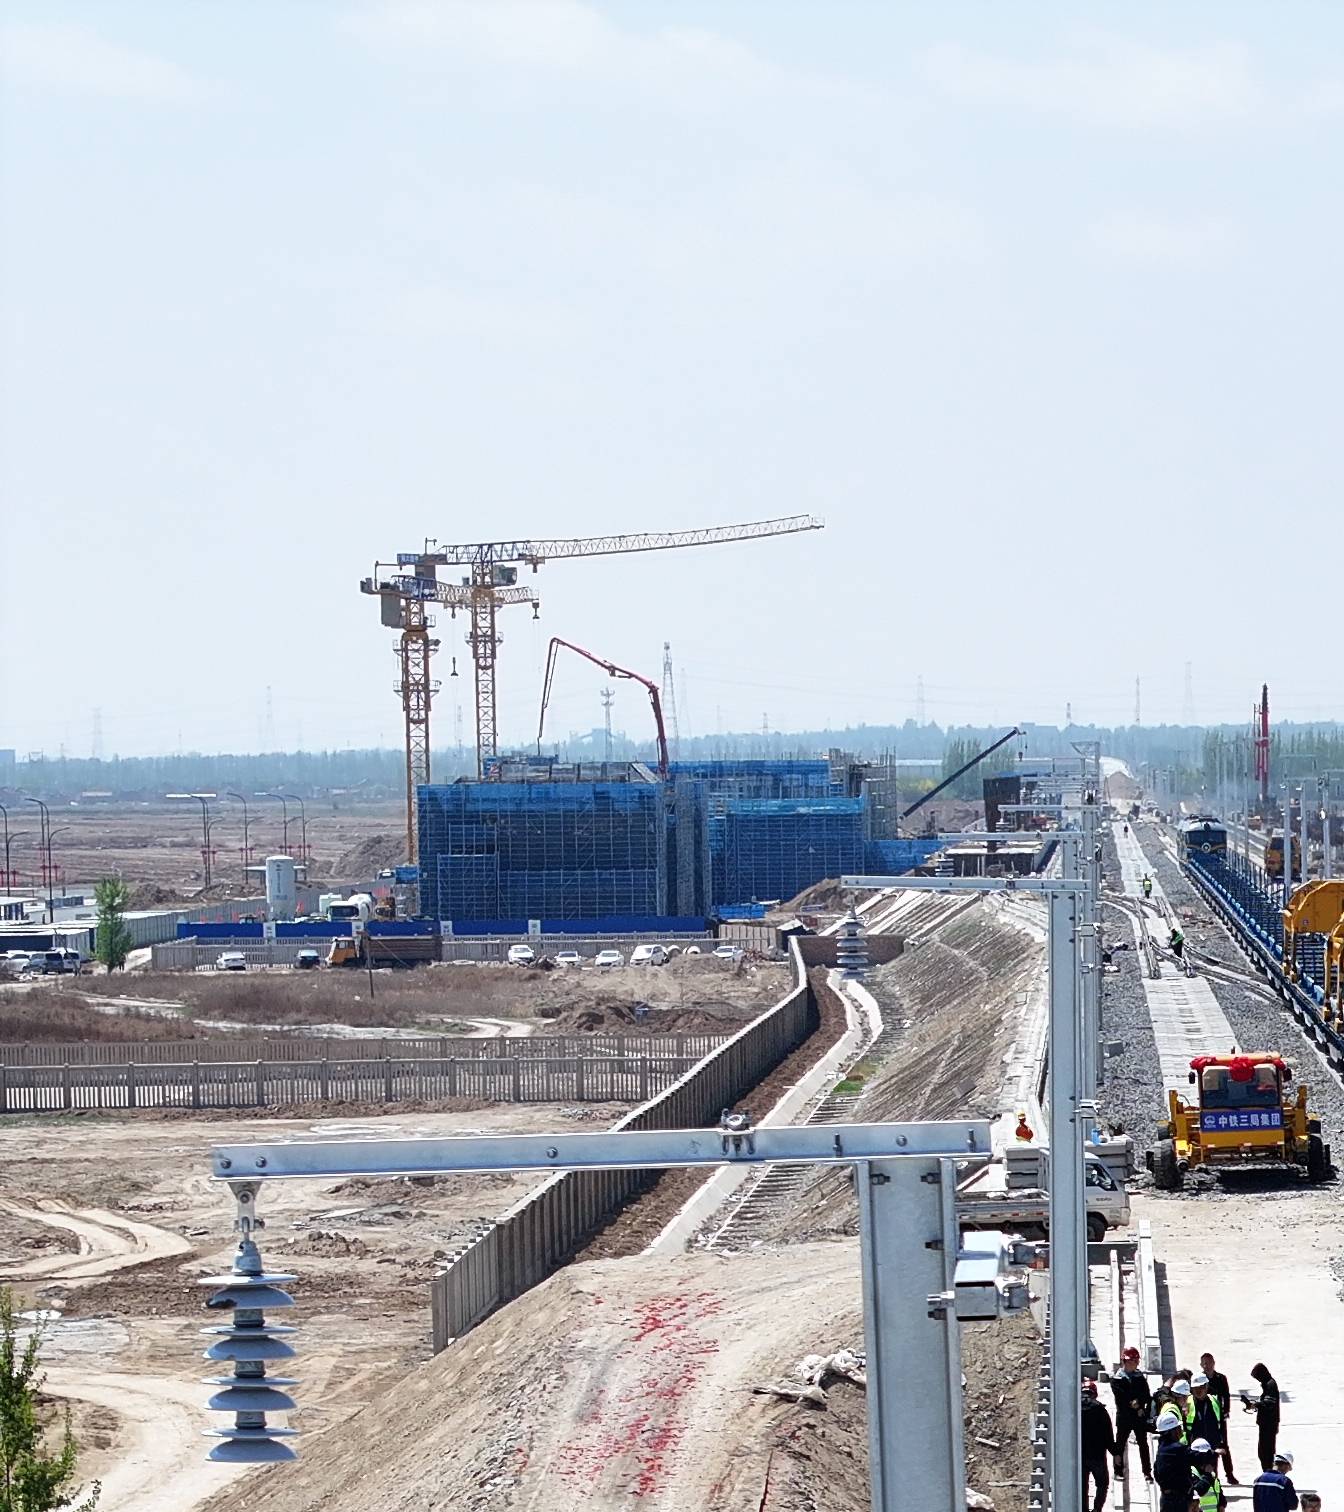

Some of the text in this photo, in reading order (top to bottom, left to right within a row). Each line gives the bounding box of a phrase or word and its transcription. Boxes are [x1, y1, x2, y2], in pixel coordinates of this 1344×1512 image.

[1218, 1113, 1280, 1128] 中铁三局集团
